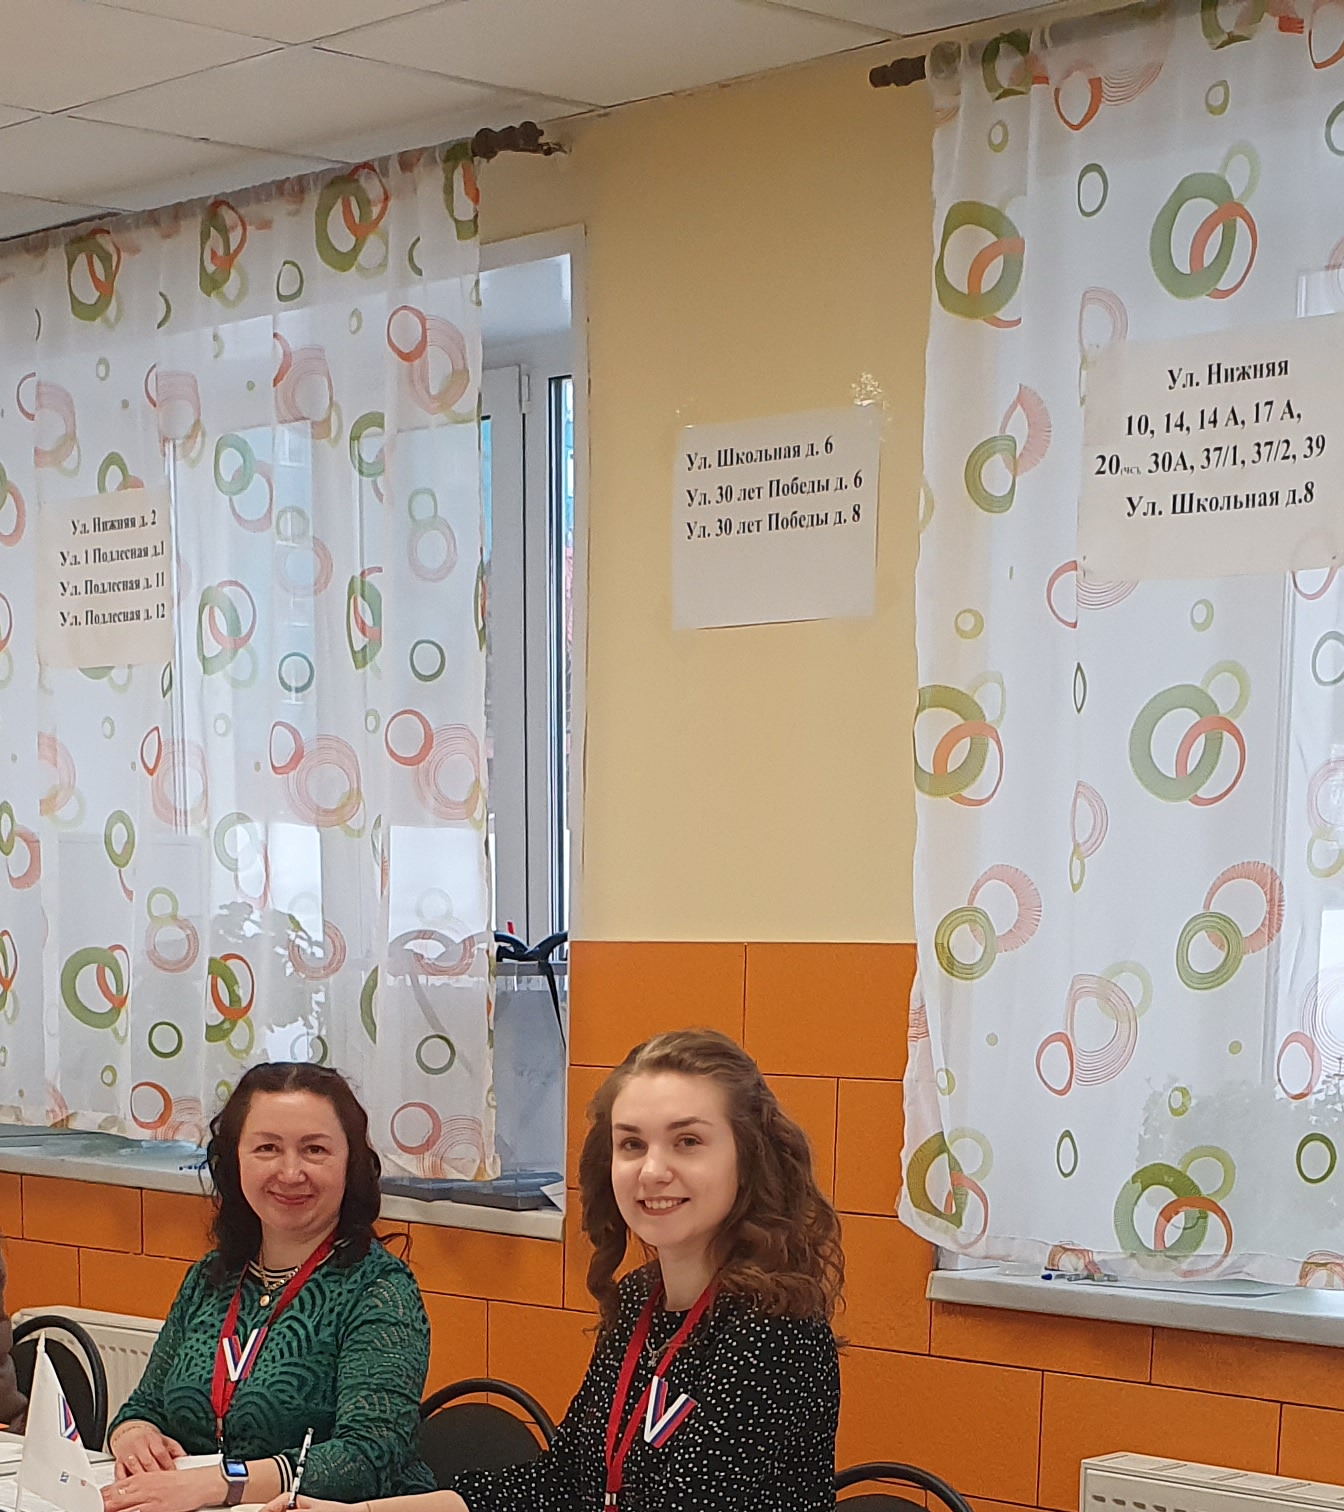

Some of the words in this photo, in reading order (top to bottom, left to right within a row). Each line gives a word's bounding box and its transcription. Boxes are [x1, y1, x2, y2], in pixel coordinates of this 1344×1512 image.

[1167, 368, 1200, 390] Ул.
[1207, 360, 1289, 386] Нижняя
[1125, 414, 1155, 438] 10,
[1164, 411, 1191, 435] 14,
[1198, 406, 1218, 430] 14
[1224, 405, 1246, 429] А,
[1254, 400, 1274, 424] 17
[1279, 399, 1302, 423] А,
[685, 452, 712, 471] Ул.
[717, 445, 801, 468] Школьная
[805, 442, 819, 458] д.
[824, 435, 834, 454] 6
[1147, 452, 1195, 474] 30А,
[1200, 444, 1246, 470] 37/1,
[1250, 438, 1296, 465] 37/2,
[1302, 434, 1326, 460] 39
[685, 488, 712, 508] Ул.
[715, 485, 733, 504] 30
[737, 486, 764, 502] лет
[768, 476, 830, 499] Победы
[833, 475, 848, 492] д.
[853, 469, 863, 489] 6
[1126, 496, 1164, 518] Ул.
[1170, 489, 1280, 515] Школьная
[1285, 481, 1315, 507] д.8
[71, 519, 89, 535] Ул.
[93, 517, 136, 533] Нижняя
[138, 515, 148, 528] д.
[151, 509, 156, 525] 2
[685, 521, 711, 540] Ул.
[715, 518, 733, 537] 30
[736, 519, 763, 535] лет
[767, 510, 829, 532] Победы
[833, 510, 847, 526] д.
[852, 503, 861, 523] 8
[59, 551, 81, 566] Ул.
[85, 549, 89, 564] 1
[93, 546, 149, 564] Подлесная
[151, 541, 164, 557] д.1
[59, 581, 81, 596] Ул.
[84, 576, 141, 595] Подлесная
[143, 577, 152, 590] д.
[156, 572, 165, 588] 11
[59, 611, 81, 627] Ул.
[85, 609, 141, 626] Подлесная
[143, 608, 153, 621] д.
[156, 603, 166, 619] 12
